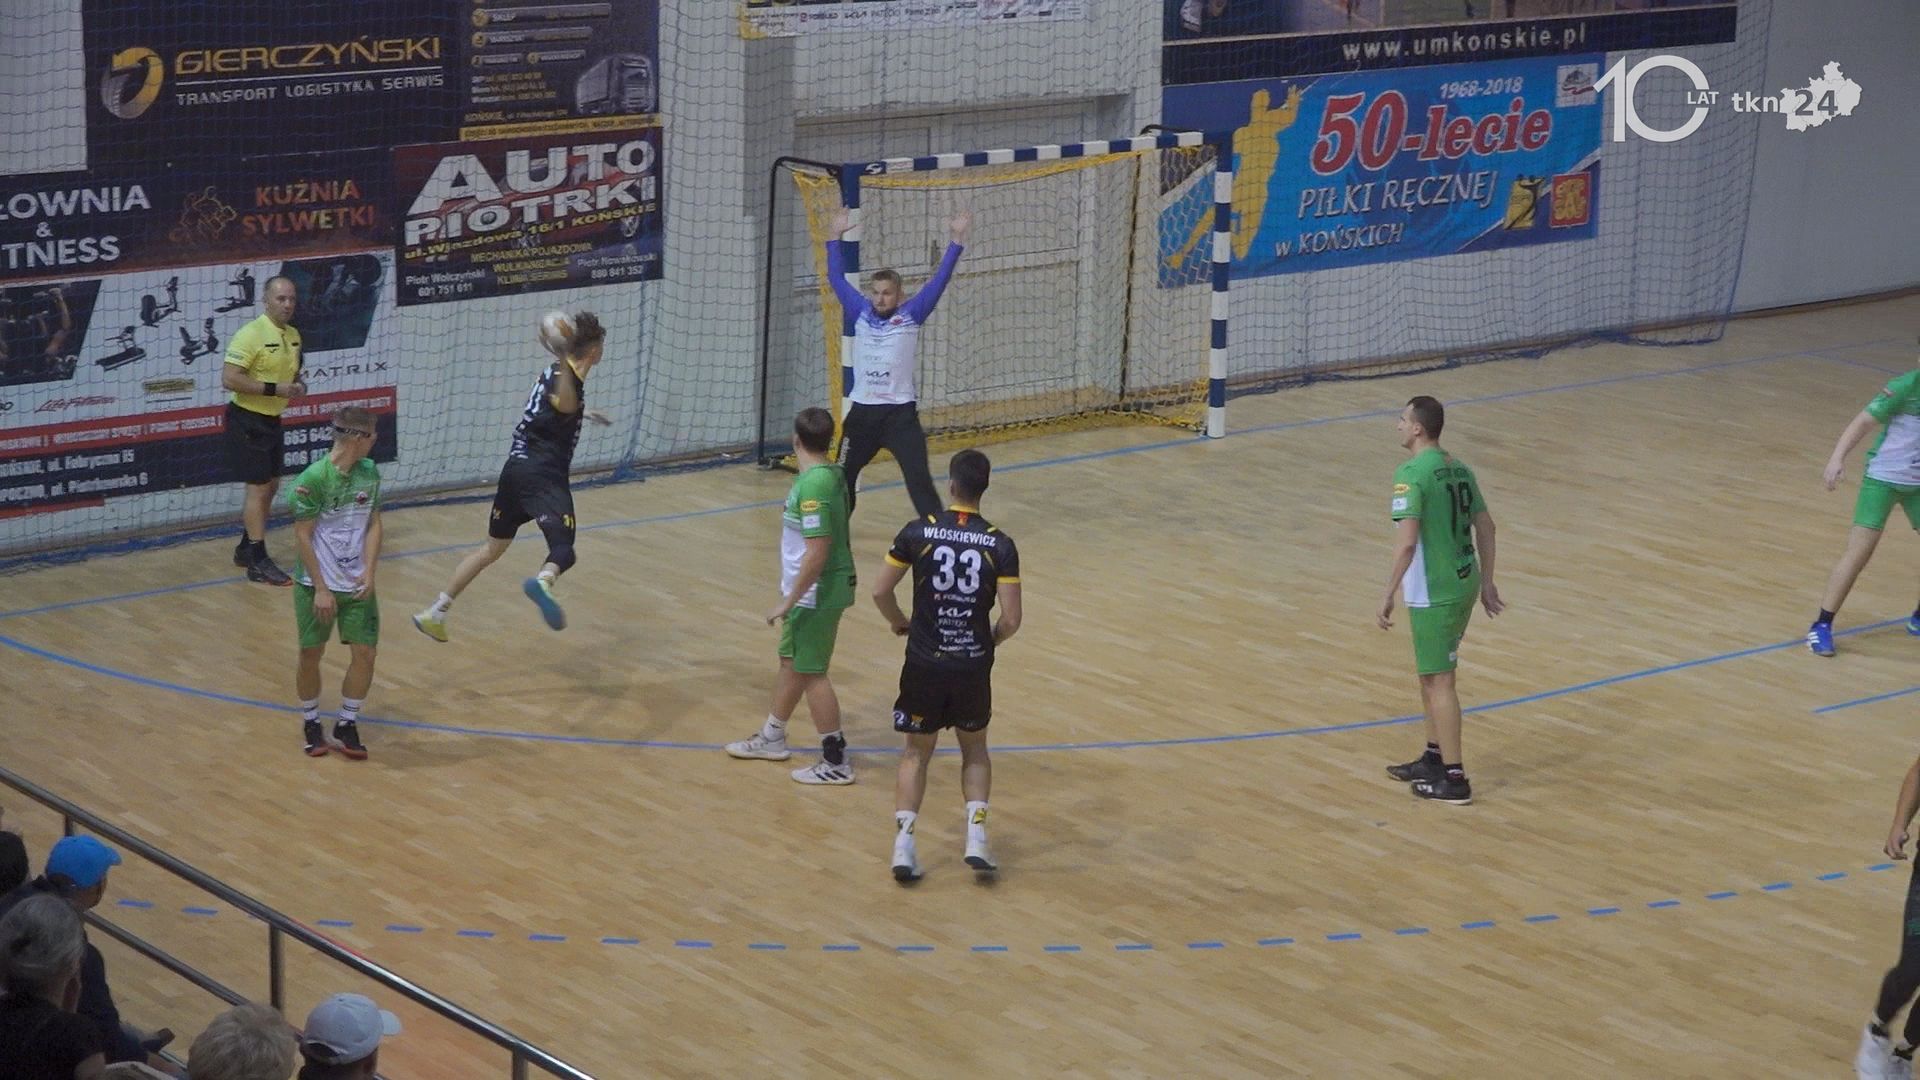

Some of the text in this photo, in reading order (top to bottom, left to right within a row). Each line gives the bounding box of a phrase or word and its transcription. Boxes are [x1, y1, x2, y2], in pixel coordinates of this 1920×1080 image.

[175, 35, 440, 76] GIERCZYŃSKI
[1342, 22, 1586, 61] www.umkonskie.pl
[176, 74, 444, 106] TRANSPORT LOGISTYKA SERWIS
[1440, 76, 1524, 99] 1968-2018
[1310, 90, 1553, 176] 50-lecie
[407, 140, 656, 216] AUTO
[255, 179, 361, 207] KUŹNIA
[1297, 170, 1499, 219] PIŁKI RĘCZNEJ
[242, 205, 376, 234] SYLWETKI
[404, 176, 657, 246] PIOTRKI
[36, 222, 53, 238] &
[1299, 221, 1406, 254] KOŃSKICH
[577, 258, 599, 268] Piotr
[627, 265, 644, 276] 352
[405, 274, 429, 286] Piotr
[418, 286, 435, 297] 601
[438, 284, 454, 295] 751
[284, 430, 308, 446] 665
[284, 451, 308, 467] 606
[923, 526, 996, 547] WŁOSKIEWICZ
[932, 545, 983, 594] 33
